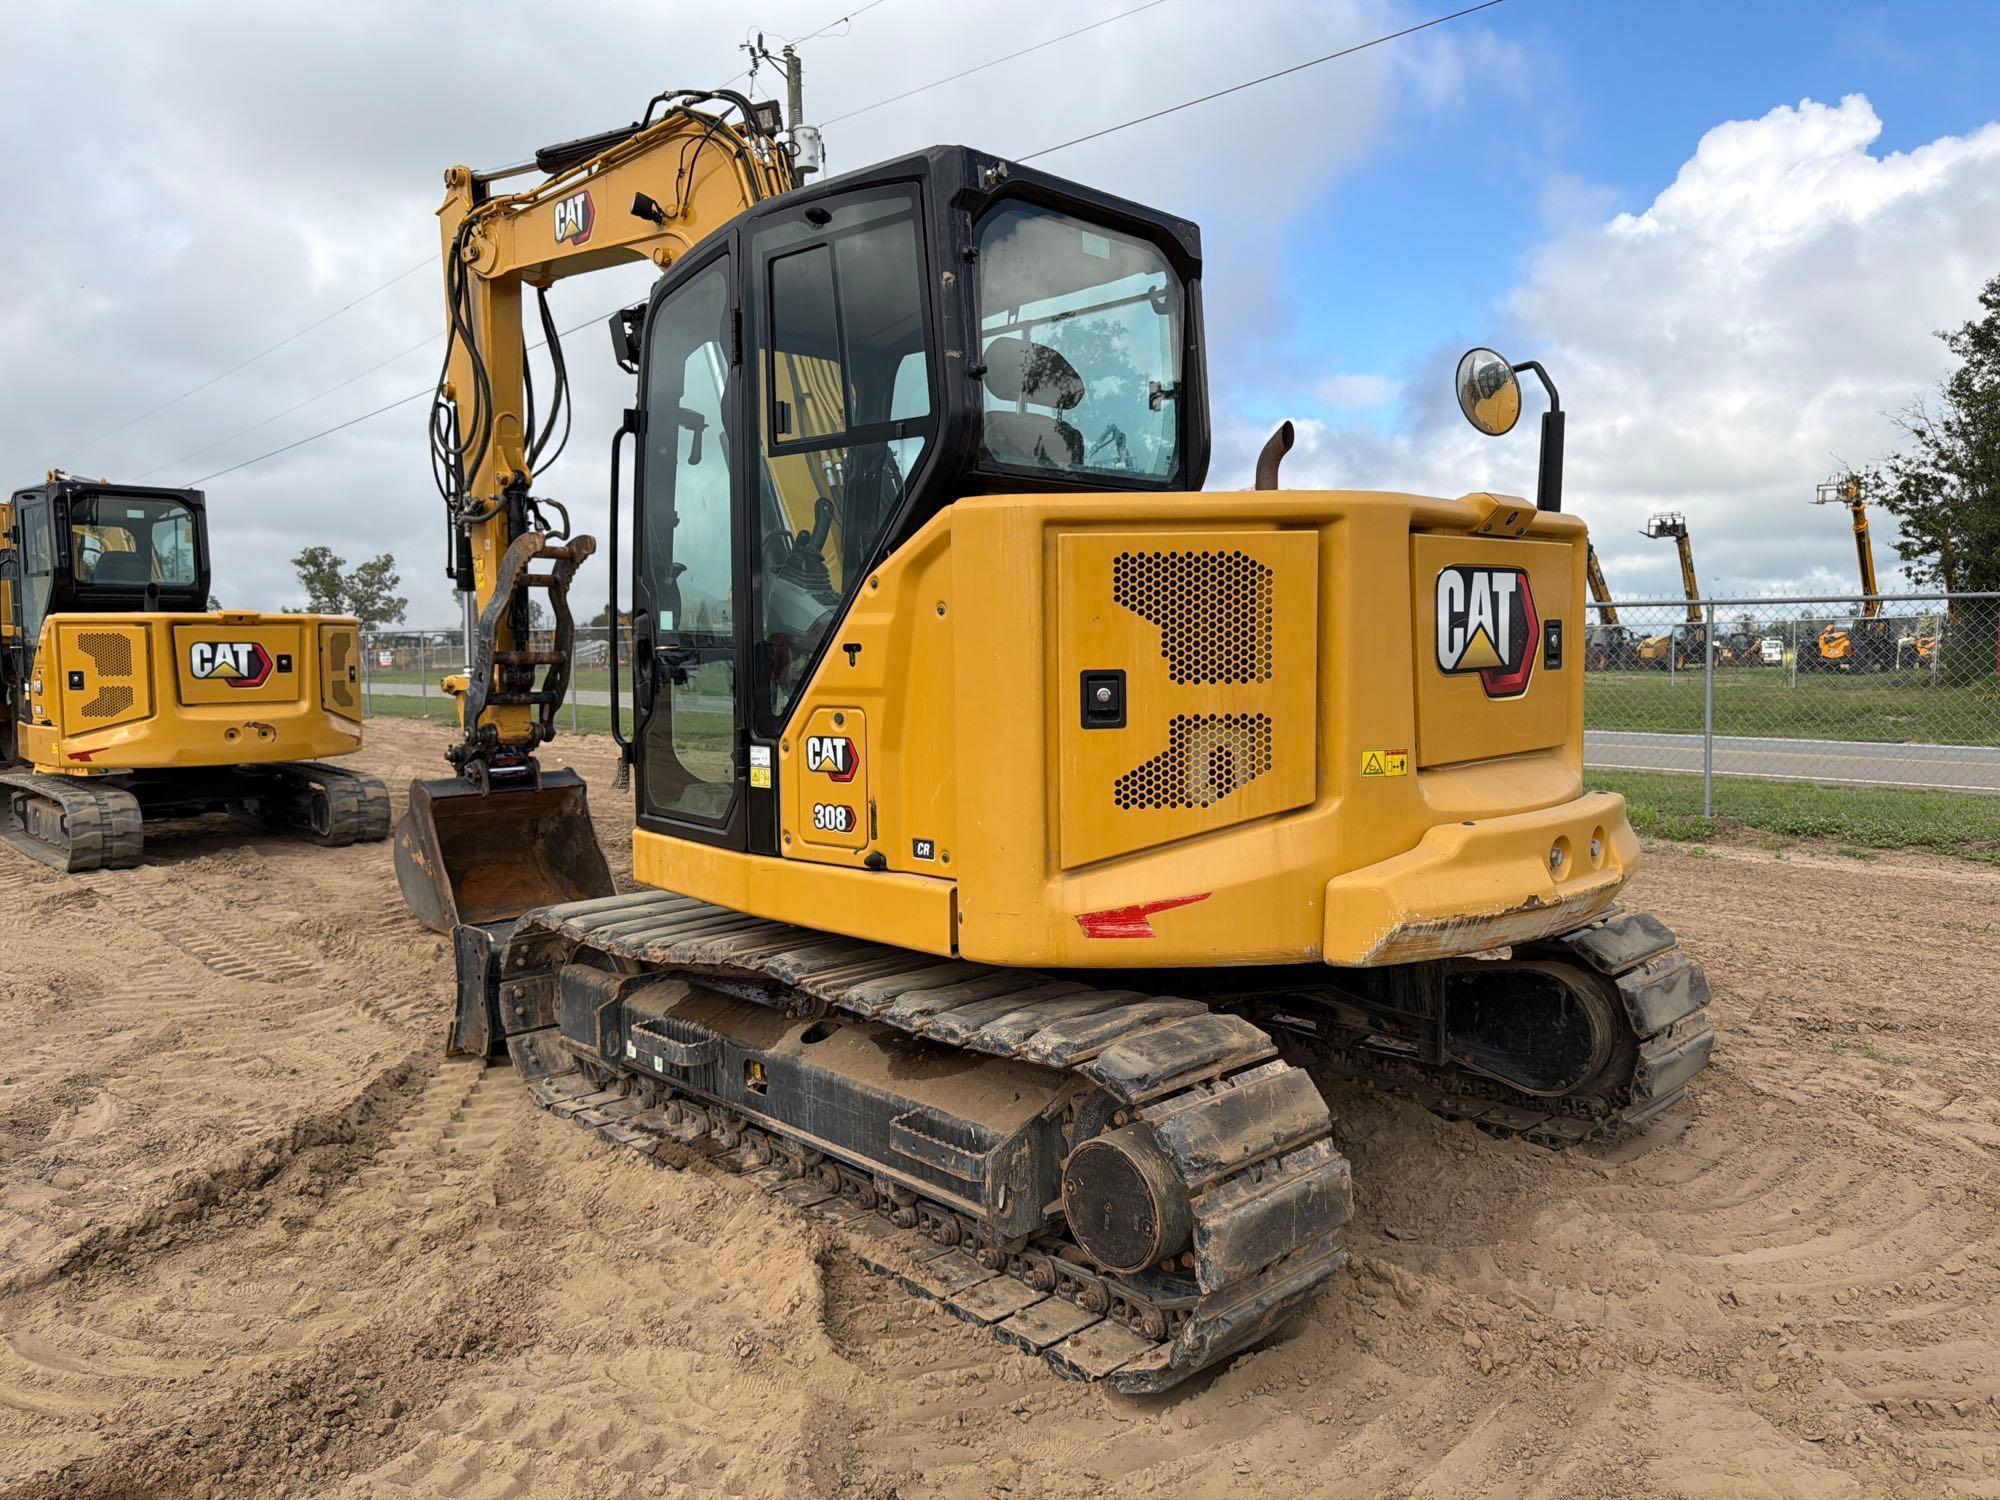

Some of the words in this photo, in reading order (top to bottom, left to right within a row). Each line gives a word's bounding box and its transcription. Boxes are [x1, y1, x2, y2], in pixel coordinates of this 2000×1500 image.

[555, 192, 585, 241] CAT
[1437, 568, 1517, 670] CAT
[191, 642, 252, 678] CAT
[807, 736, 846, 772] CAT
[814, 804, 846, 831] 308
[917, 842, 930, 856] CR
